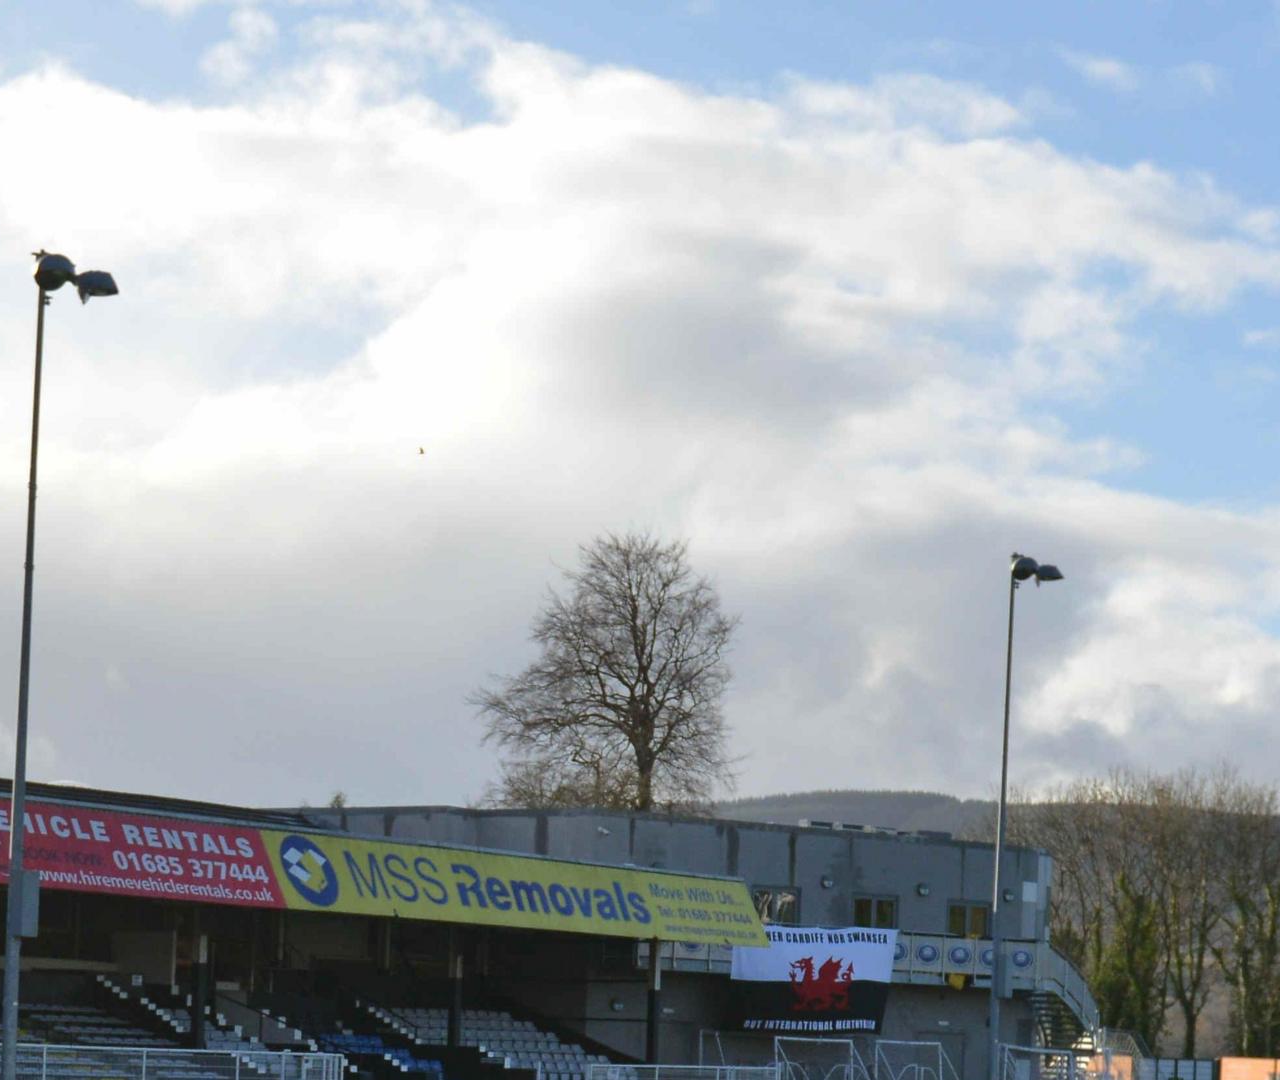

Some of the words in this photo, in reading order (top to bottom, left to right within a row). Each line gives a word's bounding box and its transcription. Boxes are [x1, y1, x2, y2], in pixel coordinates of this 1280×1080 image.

[121, 823, 255, 858] RENTALS
[112, 849, 184, 876] 01685
[187, 857, 269, 884] 377444
[38, 869, 274, 902] www.hiremevehiclerentals.co.uk
[343, 850, 449, 905] MSS
[450, 862, 651, 924] Removals
[648, 883, 683, 900] Move
[687, 886, 714, 903] With
[785, 932, 824, 944] CARDIFF
[827, 933, 846, 944] NOR
[847, 932, 888, 945] SWANSEA
[764, 1019, 833, 1031] INTERNATIONAL
